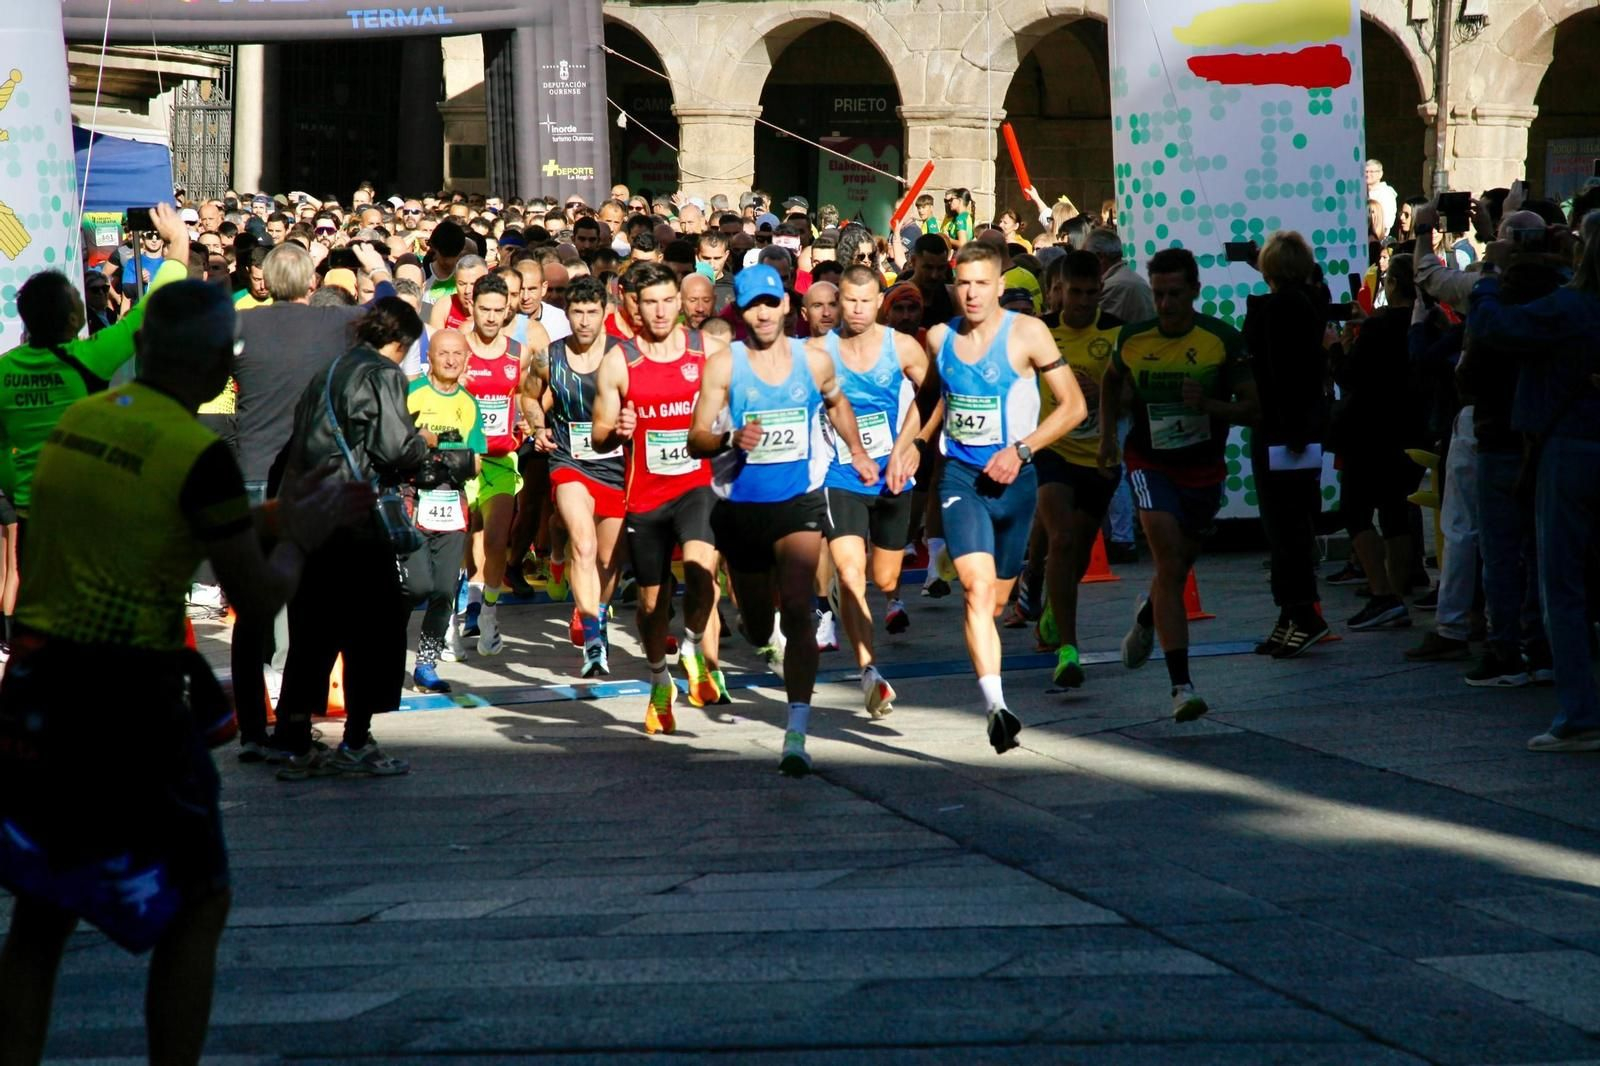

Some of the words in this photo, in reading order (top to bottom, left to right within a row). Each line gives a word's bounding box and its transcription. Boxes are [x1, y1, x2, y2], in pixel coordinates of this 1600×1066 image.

[346, 6, 453, 29] TERMAL
[543, 81, 587, 89] DEPUTACIÓN
[548, 88, 581, 96] OURENSE
[834, 97, 887, 112] PRIETO
[843, 172, 877, 185] propia
[4, 373, 65, 387] GUARDIA
[15, 391, 55, 406] CIVIL
[481, 413, 497, 424] 29
[955, 412, 986, 430] 347
[430, 424, 457, 432] CARRER
[762, 429, 794, 447] 722
[862, 432, 872, 445] 5
[660, 447, 690, 460] 140
[429, 506, 453, 517] 412
